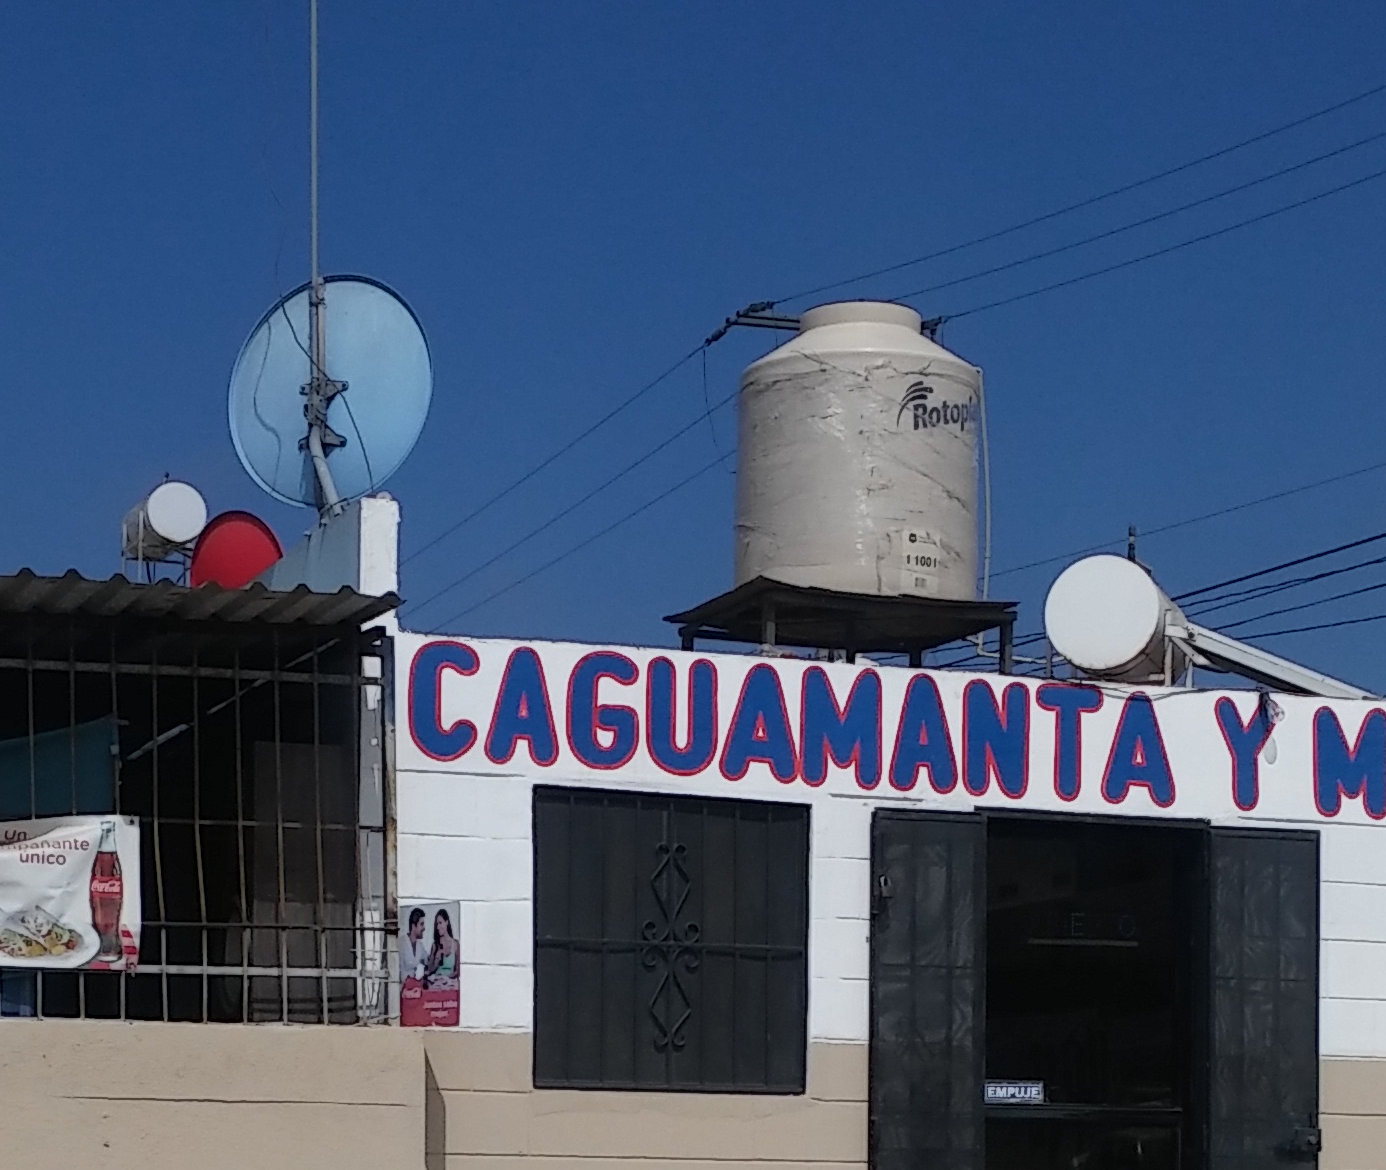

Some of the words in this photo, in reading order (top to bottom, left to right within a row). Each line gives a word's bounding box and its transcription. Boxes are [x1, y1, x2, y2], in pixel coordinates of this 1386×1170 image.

[408, 640, 1176, 809] CAGUAMANTA
[1214, 696, 1277, 811] Y
[4, 829, 27, 841] Un
[986, 1086, 1041, 1098] EMPUJE
